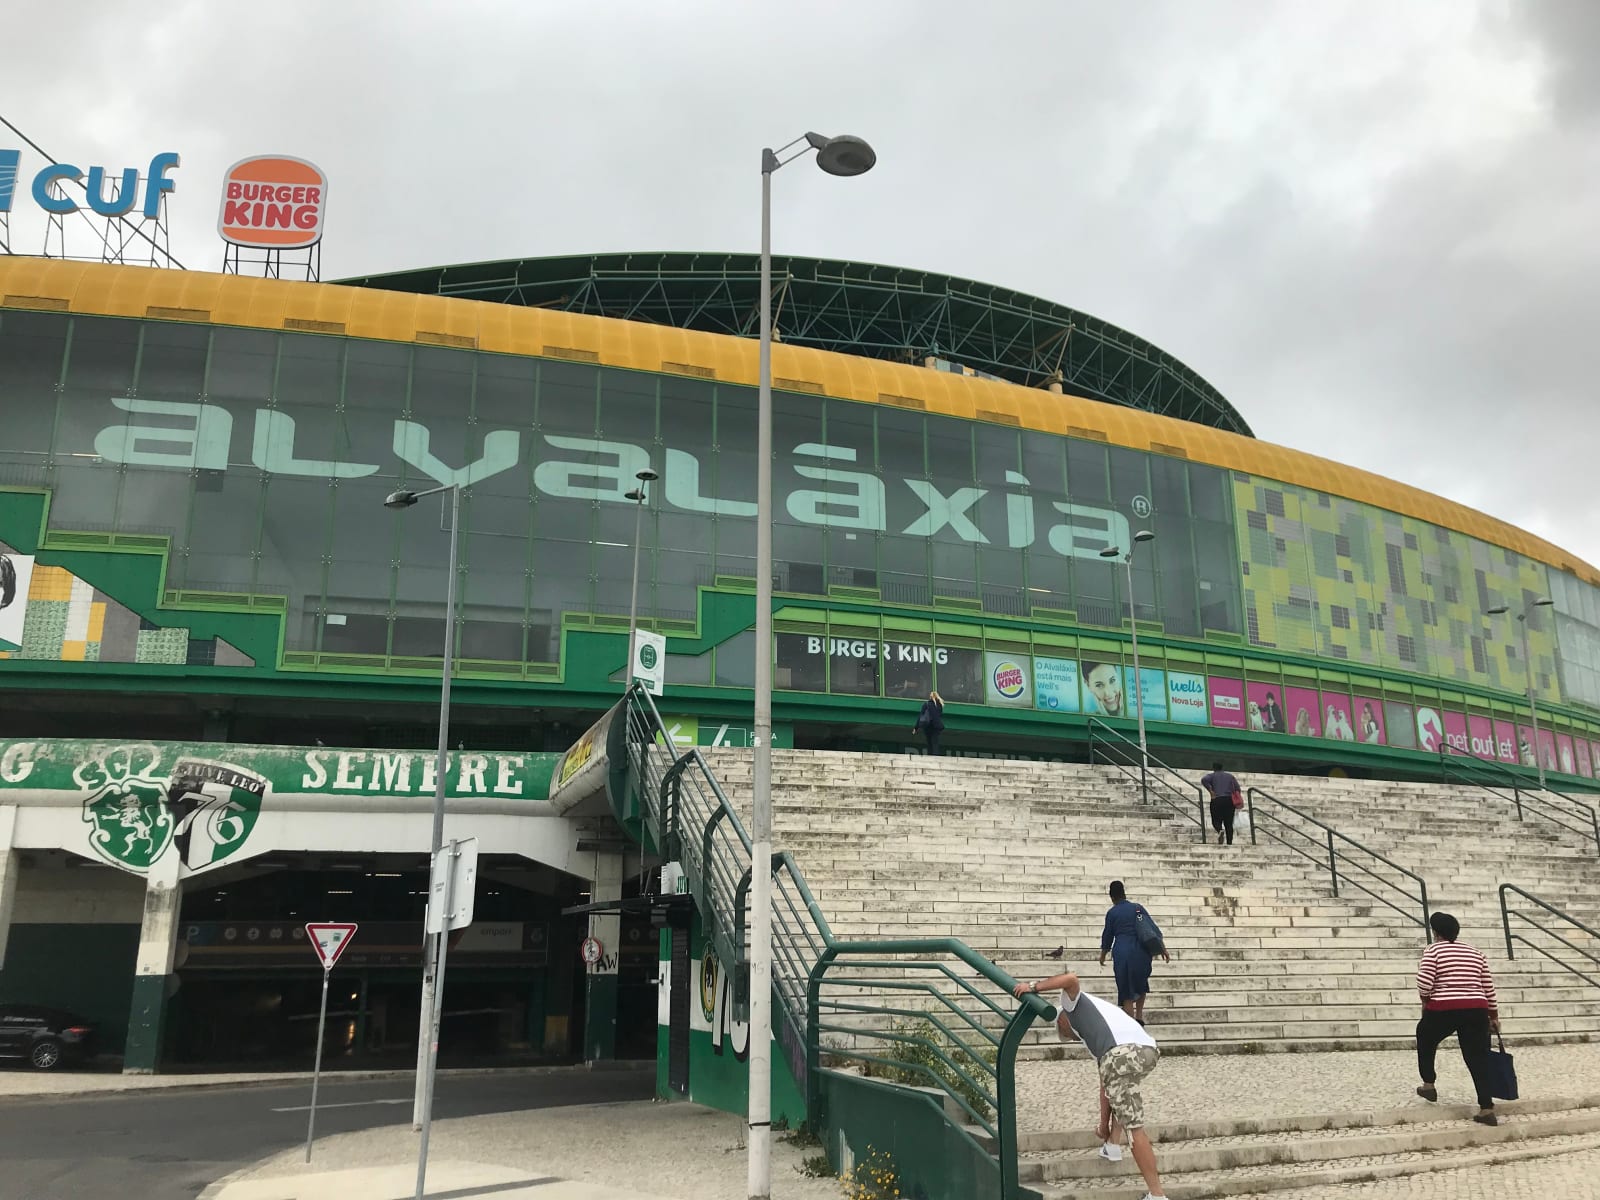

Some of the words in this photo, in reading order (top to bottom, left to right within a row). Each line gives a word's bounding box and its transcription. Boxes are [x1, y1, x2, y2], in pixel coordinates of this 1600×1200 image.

[32, 152, 181, 220] cuf
[226, 182, 321, 205] BURGER
[223, 200, 320, 230] KING
[807, 636, 891, 661] BURGER
[898, 644, 949, 665] KING
[996, 668, 1022, 681] BURGER
[998, 676, 1023, 690] KING
[1171, 696, 1190, 706] Nova
[1190, 699, 1205, 709] Loja
[1446, 731, 1469, 755] pet
[302, 750, 524, 794] SEMPRE
[229, 776, 261, 793] LEO
[174, 790, 247, 846] 76
